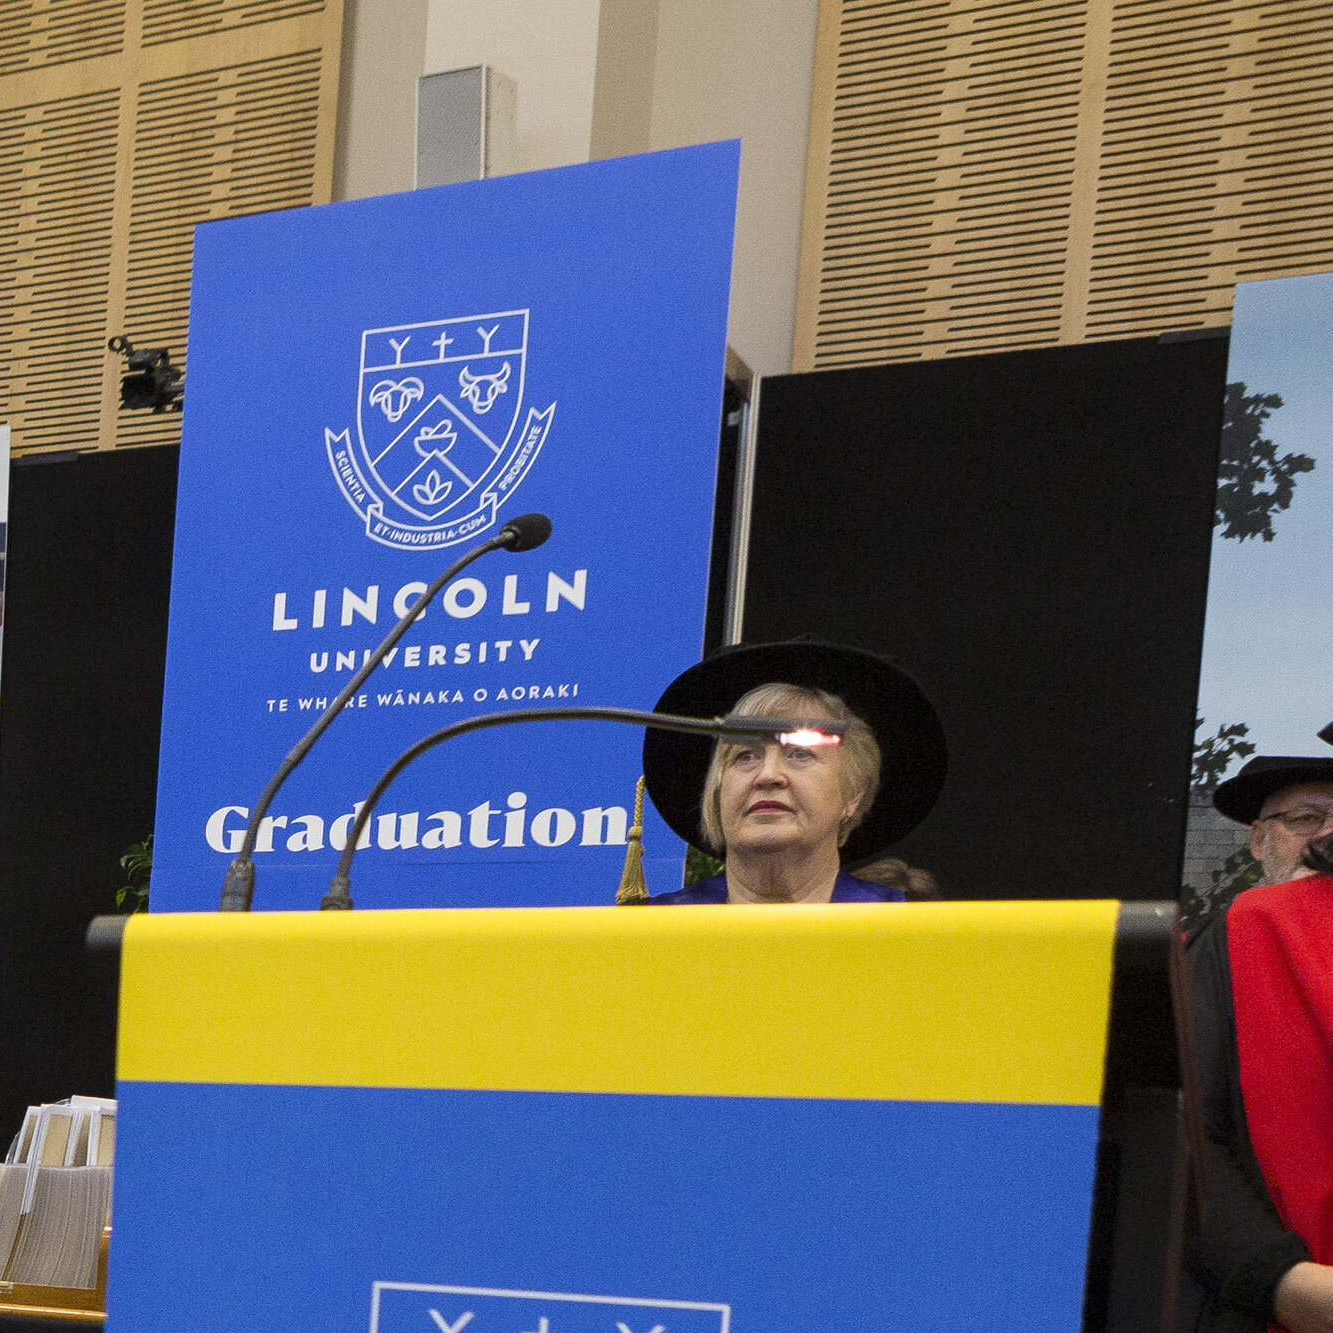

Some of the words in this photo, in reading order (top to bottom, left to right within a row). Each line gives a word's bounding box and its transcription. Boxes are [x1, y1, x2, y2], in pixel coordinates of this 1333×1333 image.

[335, 449, 367, 504] SCIENTIA
[272, 569, 588, 632] LINCOLN
[309, 638, 541, 674] UNIVERSITY
[267, 698, 289, 713] TE
[376, 688, 465, 707] WĀNAKA
[473, 688, 488, 703] O
[495, 683, 580, 703] AORAKI
[205, 791, 629, 854] Graduation
